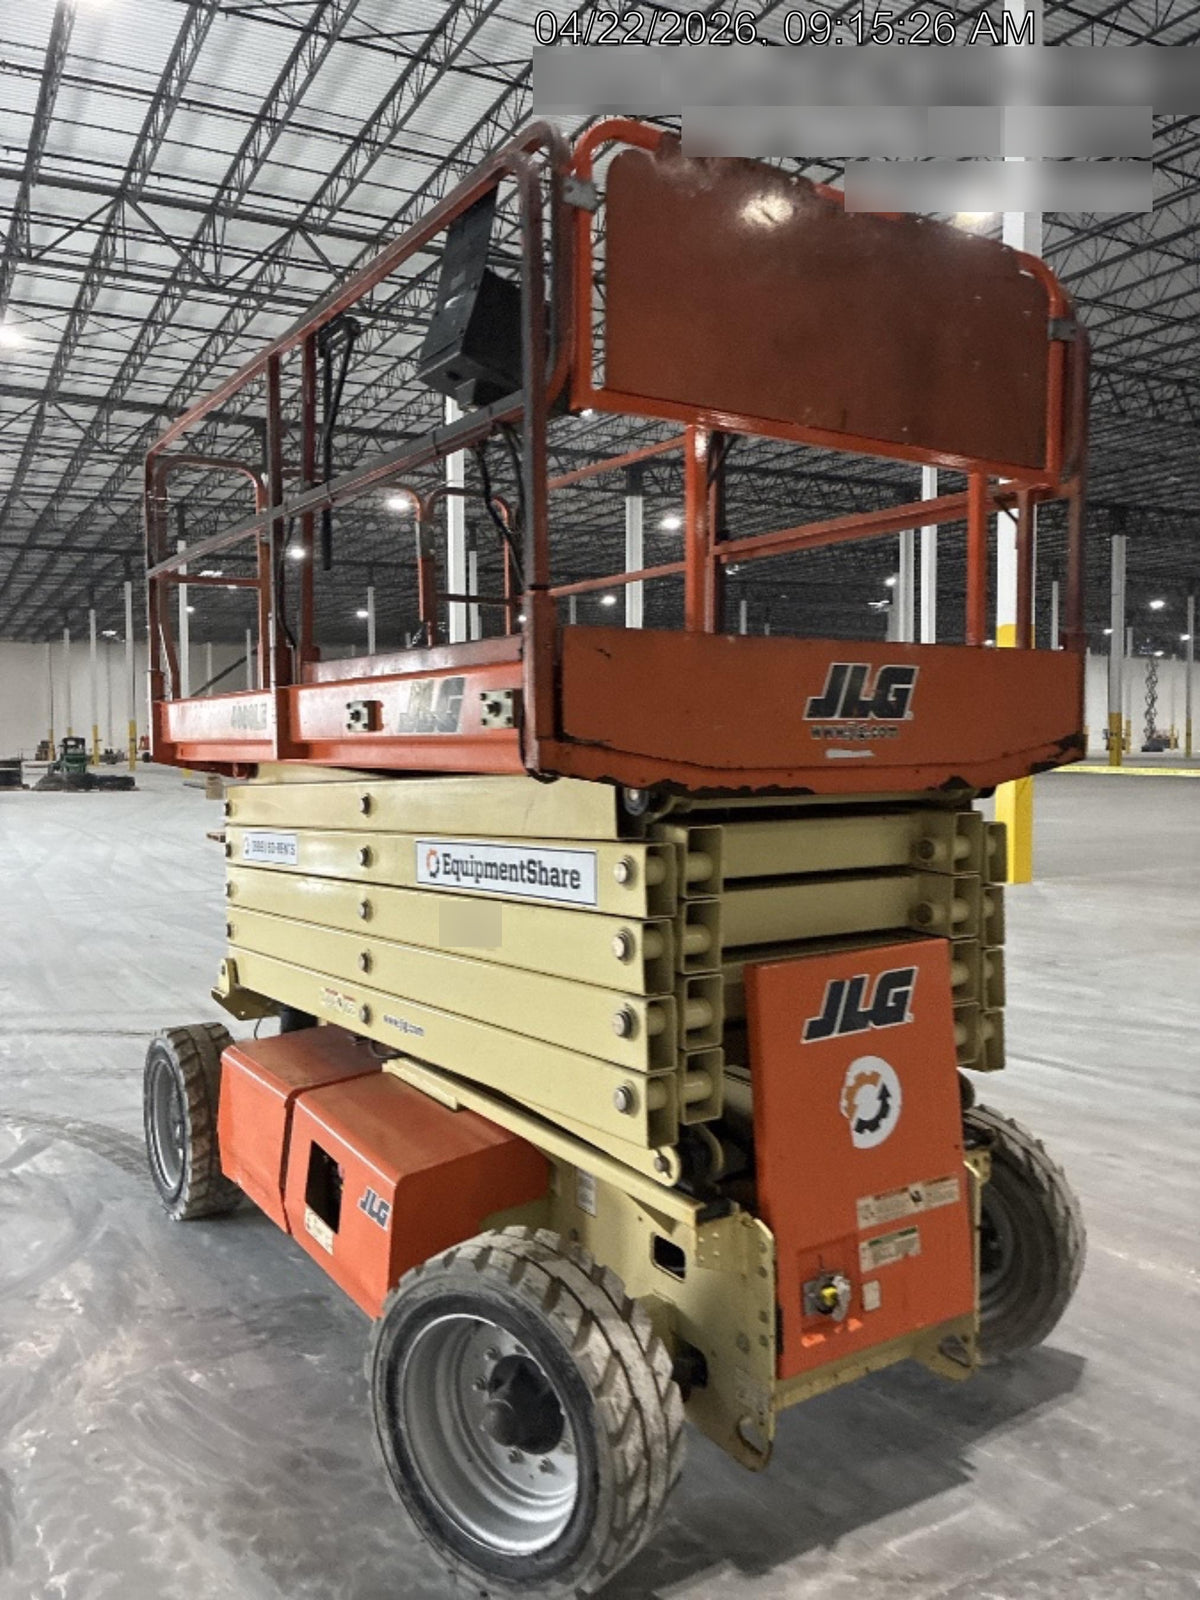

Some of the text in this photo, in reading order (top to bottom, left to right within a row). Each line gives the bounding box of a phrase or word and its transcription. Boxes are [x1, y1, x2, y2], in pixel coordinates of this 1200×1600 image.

[803, 663, 919, 720] JLG
[442, 853, 581, 889] EquipmentShare
[801, 966, 918, 1043] JLG
[358, 1187, 393, 1231] JLG
